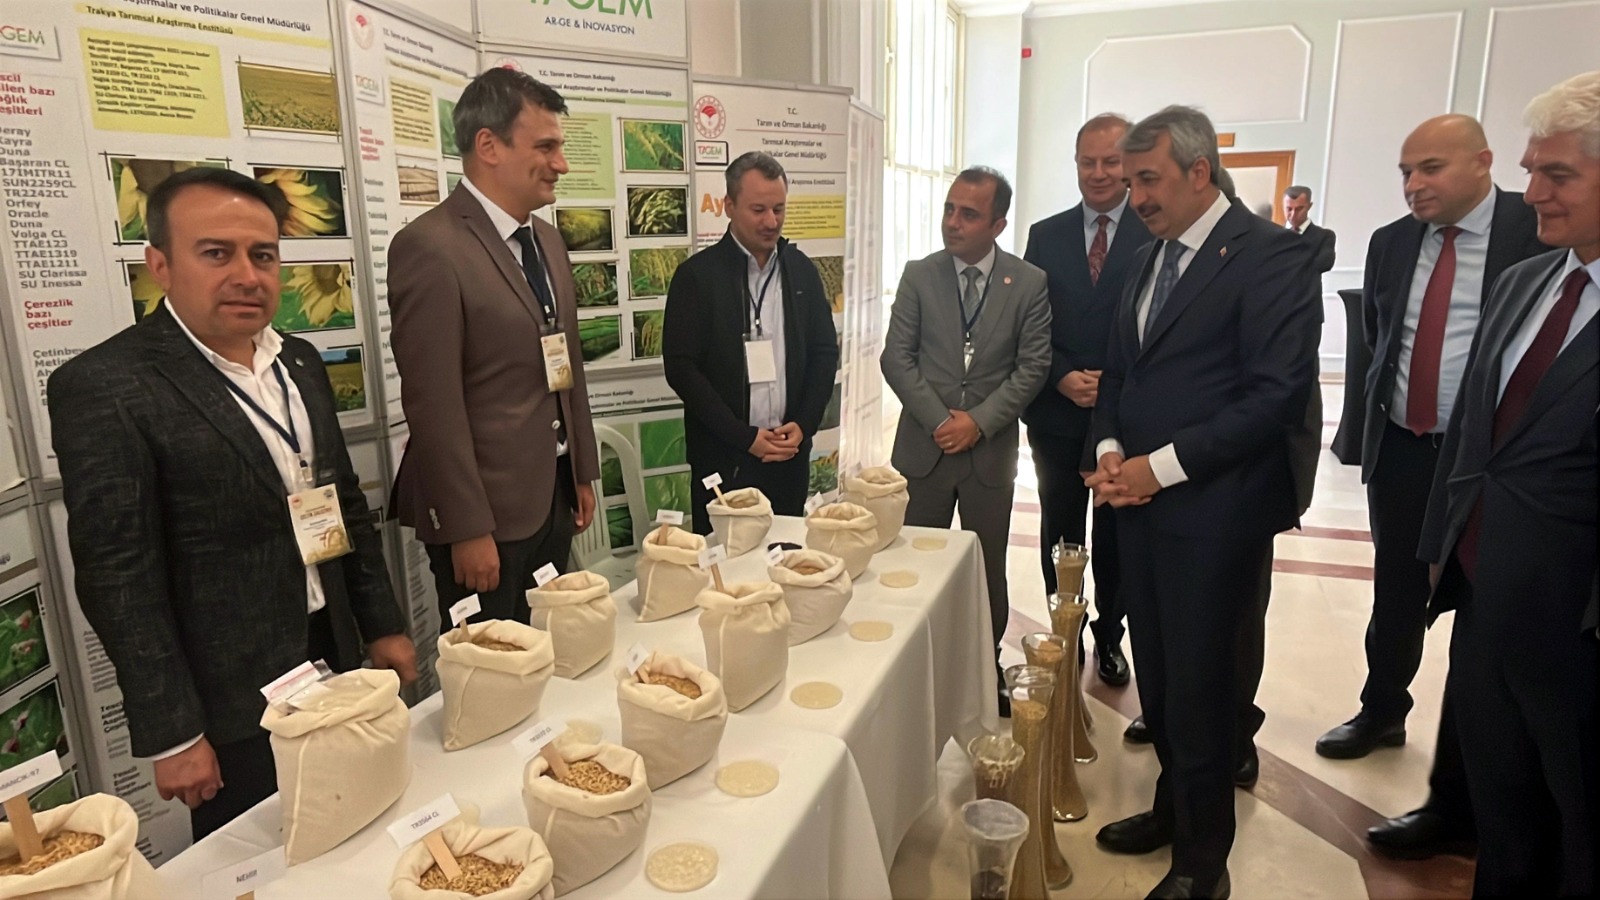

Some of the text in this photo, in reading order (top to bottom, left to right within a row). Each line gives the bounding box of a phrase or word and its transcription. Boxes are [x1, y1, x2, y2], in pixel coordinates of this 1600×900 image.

[86, 6, 116, 17] Trakya
[118, 11, 154, 22] Tarımsal
[157, 16, 196, 29] Araştırma
[123, 0, 310, 32] ştırmalar ve Politikalar Genel Müdürlüğü
[574, 20, 580, 28] &
[582, 18, 634, 34] İNOVASYON
[30, 85, 55, 96] bazı
[787, 107, 798, 115] T.C.
[756, 119, 772, 127] Tarım
[782, 120, 801, 128] Orman
[0, 126, 30, 137] eray
[54, 160, 70, 168] CL
[4, 189, 68, 198] TR2242CL
[6, 199, 40, 209] Orfey
[8, 210, 48, 218] Oracle
[10, 220, 42, 228] Duna
[11, 230, 67, 240] Volga CL
[19, 270, 87, 279] SU Clarissa
[21, 280, 82, 289] SU Inessa
[24, 299, 73, 310] Çerezlik
[26, 311, 52, 319] bazı
[27, 319, 73, 330] çeşitler
